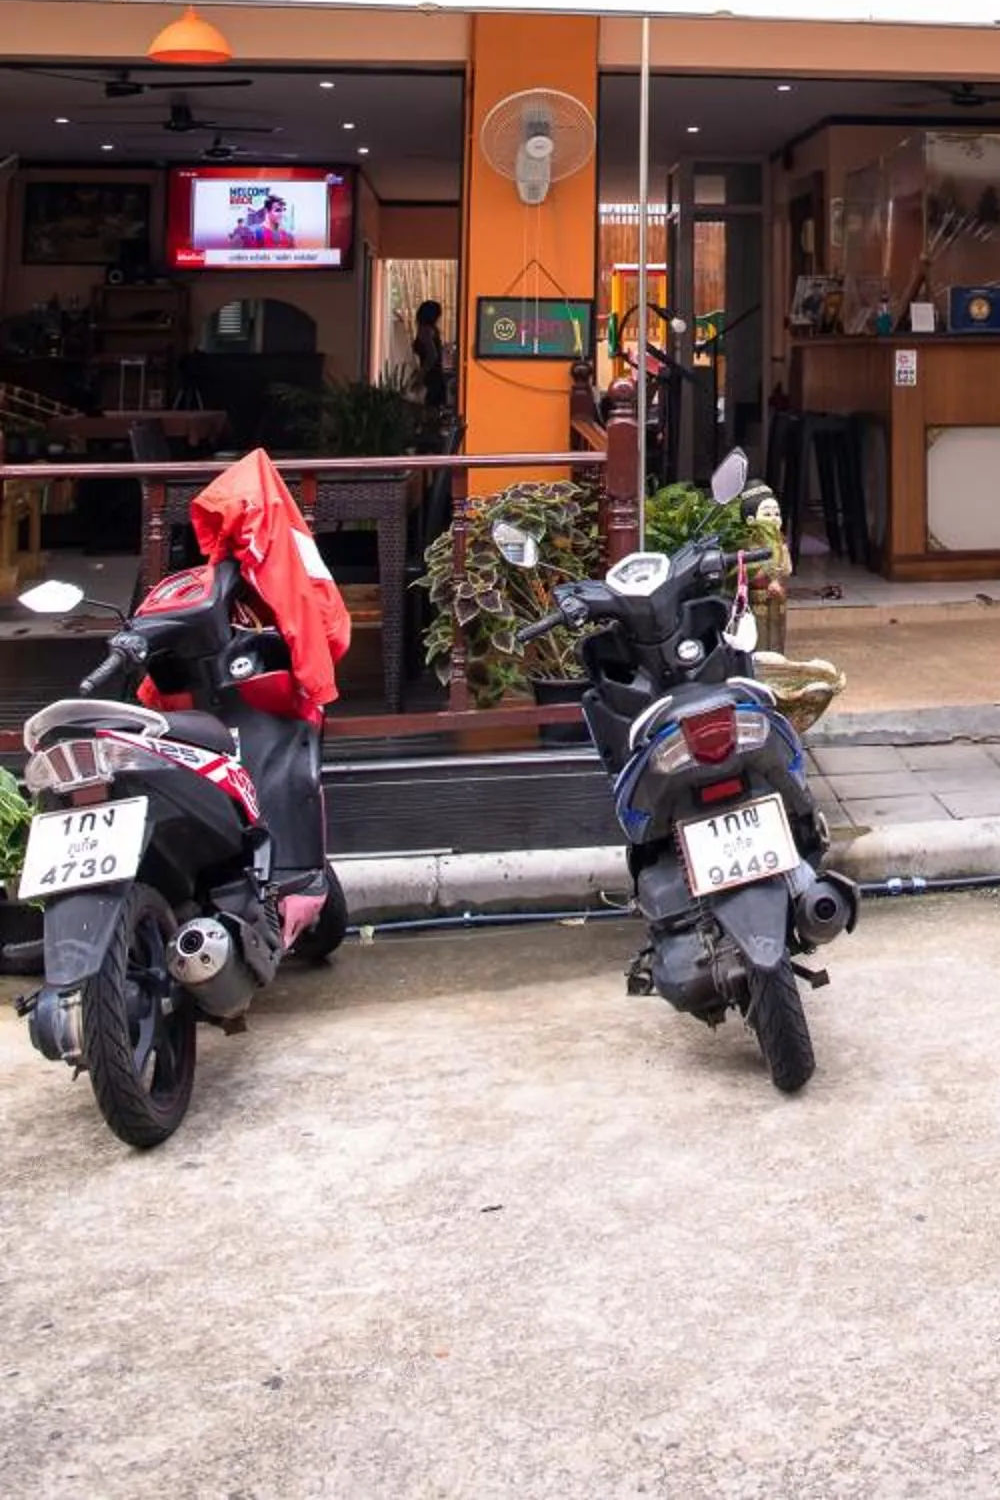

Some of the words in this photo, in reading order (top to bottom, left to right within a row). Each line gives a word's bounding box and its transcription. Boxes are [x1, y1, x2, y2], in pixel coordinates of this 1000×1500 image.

[148, 740, 201, 764] 125
[40, 854, 117, 885] 4730
[708, 850, 779, 885] 9449
